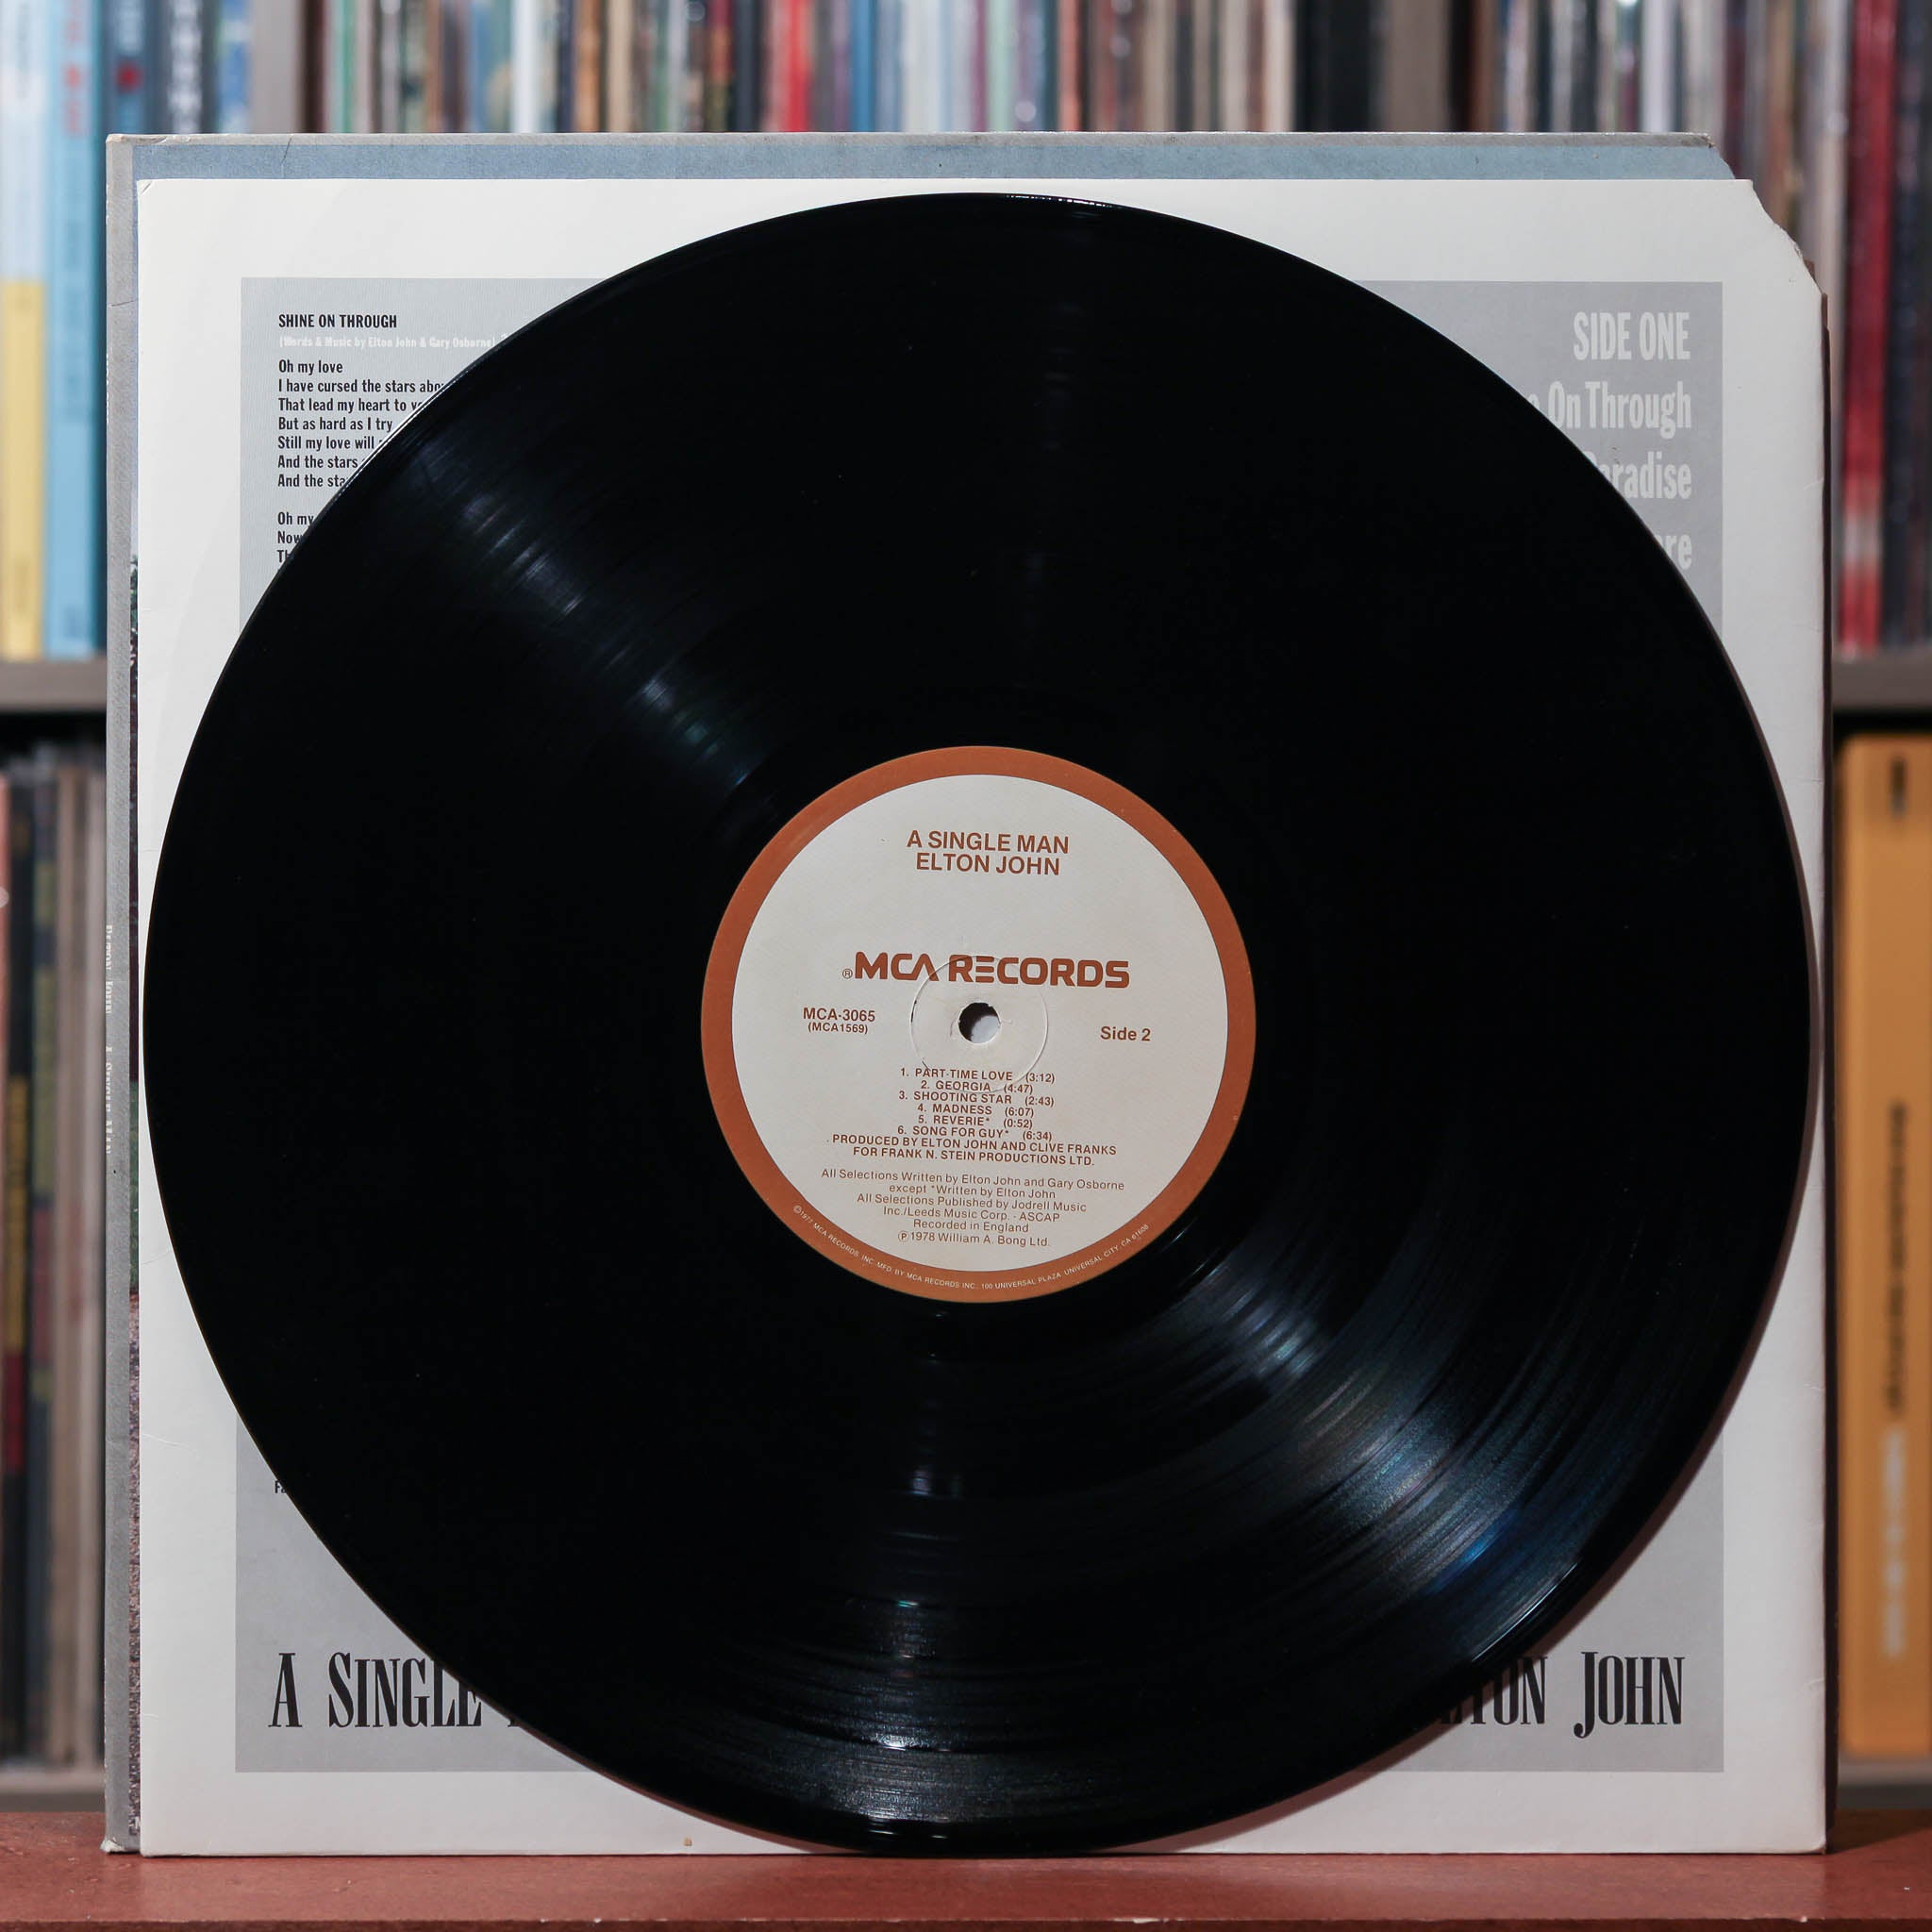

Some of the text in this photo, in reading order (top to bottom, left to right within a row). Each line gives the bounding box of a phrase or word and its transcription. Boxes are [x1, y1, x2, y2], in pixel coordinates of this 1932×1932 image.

[278, 314, 397, 328] SHINE ON THROUGH
[354, 336, 366, 350] by
[368, 336, 393, 348] Elton
[395, 336, 417, 348] John
[429, 336, 450, 350] Gary
[1574, 311, 1691, 361] SIDE ONE
[278, 359, 343, 375] Oh my love
[278, 378, 282, 392] I
[286, 378, 313, 392] have
[318, 378, 358, 392] cursed
[362, 378, 381, 392] the
[385, 379, 416, 392] stars
[278, 398, 305, 411] That
[308, 398, 334, 411] lead
[337, 401, 354, 414] my
[358, 398, 391, 411] heart
[394, 398, 407, 411] to
[1547, 380, 1691, 440] On Through
[278, 417, 392, 433] But as hard as I try
[277, 436, 375, 453] Still my love will
[277, 455, 358, 468] And the stars
[277, 474, 300, 487] And
[305, 474, 324, 487] the
[277, 511, 314, 528] Oh my
[907, 829, 1069, 854] A SINGLE MAN
[916, 852, 1059, 875] ELTON JOHN
[855, 951, 1130, 989] MCA RECORDS
[803, 1007, 875, 1023] MCA-3065
[808, 1022, 869, 1035] (MCA1569)
[1100, 1025, 1151, 1041] Side 2
[901, 1067, 1055, 1084] 1. PART-TIME LOVE (3:12)
[921, 1080, 1033, 1094] 2. GEORGIA (4:47)
[899, 1091, 1054, 1108] 3. SHOOTING STAR (2:43)
[917, 1103, 1034, 1118] 4. MADNESS (6:07)
[918, 1114, 926, 1124] 5.
[1003, 1118, 1033, 1129] (0:52)
[897, 1125, 907, 1135] 6.
[912, 1125, 947, 1136] SONG
[951, 1127, 975, 1137] FOR
[1023, 1131, 1052, 1141] (6:34)
[832, 1134, 1117, 1156] PRODUCED BY ELTON JOHN AND CLIVE FRANKS
[853, 1146, 1095, 1166] FOR FRANK N. STEIN PRODUCTIONS LTD.
[822, 1169, 1124, 1191] All Selections Written by Elton John and Gary Osborne
[889, 1184, 926, 1195] except
[980, 1187, 993, 1197] by
[996, 1188, 1025, 1198] Elton
[1028, 1189, 1056, 1199] John
[857, 1193, 1087, 1212] All Selections Published by Jodrell Music
[883, 1206, 1060, 1223] Inc./Leeds Music Corp. ASCAP
[913, 1219, 1029, 1234] Recorded in England
[910, 1231, 936, 1242] 1978
[938, 1233, 980, 1243] William
[983, 1235, 994, 1244] A.
[997, 1235, 1026, 1247] Bong
[906, 1273, 923, 1282] MCA
[995, 1278, 1036, 1290] UNIVERSAL
[1064, 1256, 1103, 1276] UNIVERSAL
[267, 1652, 303, 1728] A
